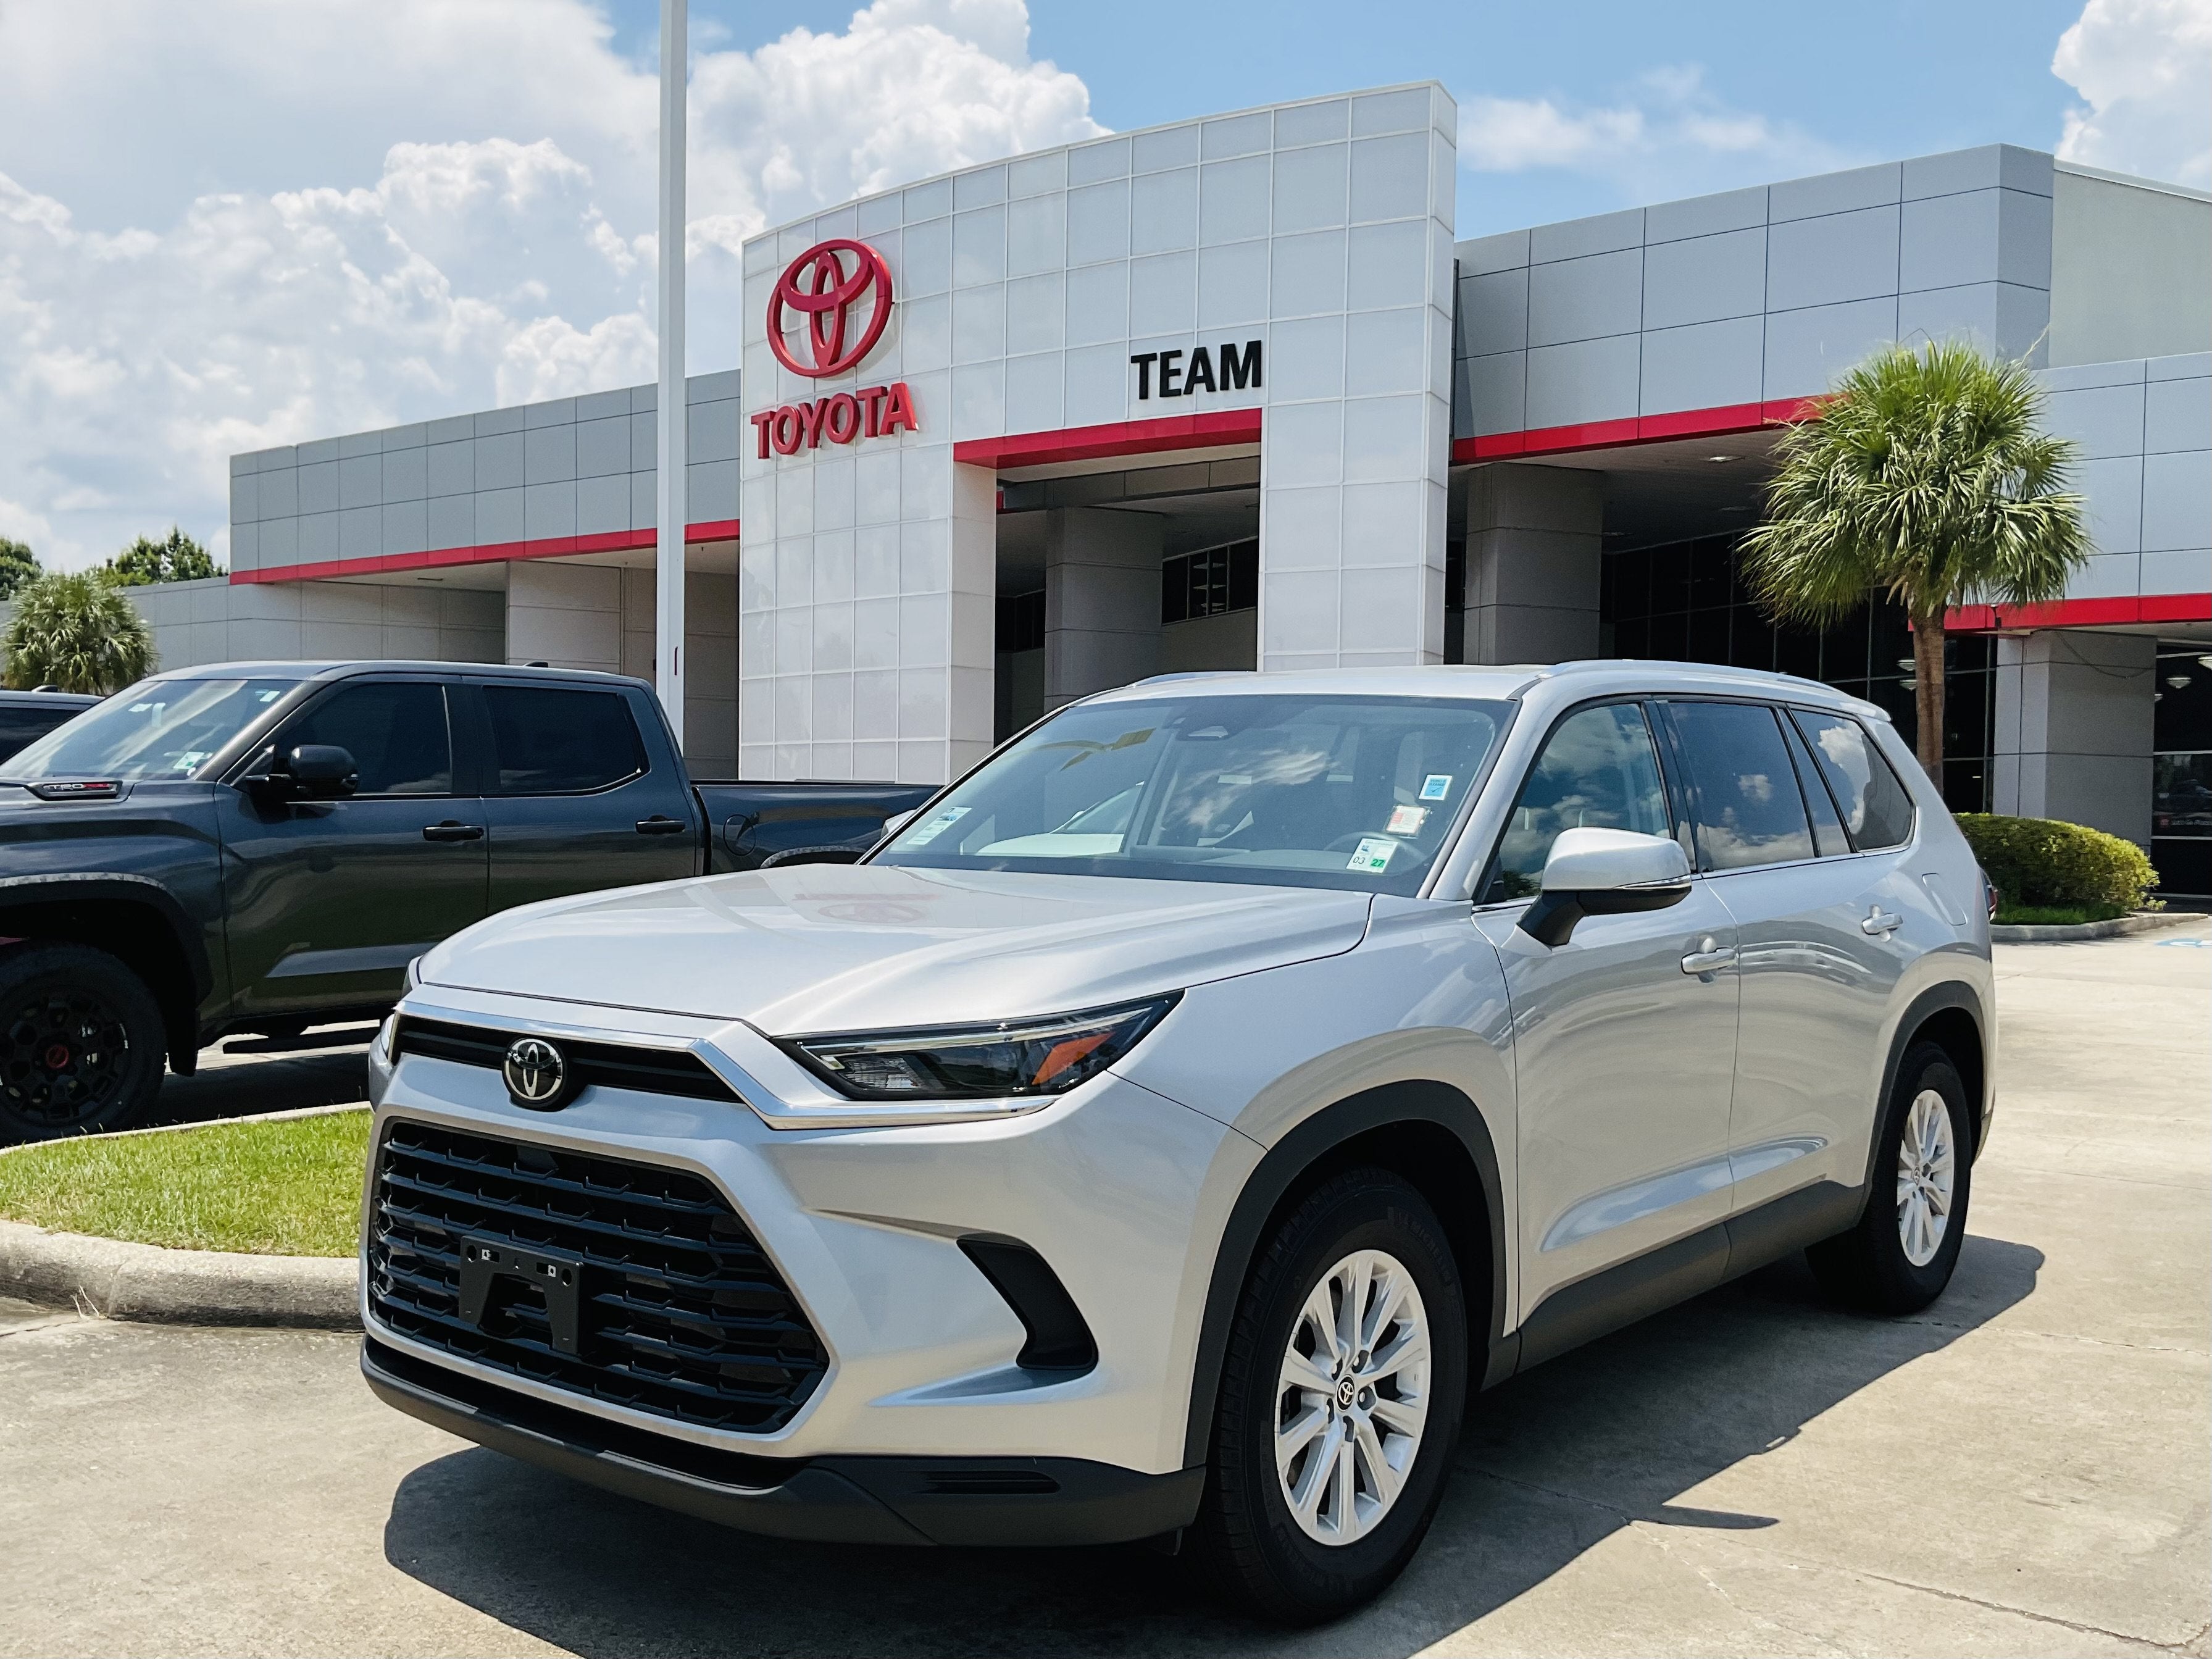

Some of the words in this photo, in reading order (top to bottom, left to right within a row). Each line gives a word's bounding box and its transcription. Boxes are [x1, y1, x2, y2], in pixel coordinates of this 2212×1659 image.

[1130, 340, 1261, 399] TEAM
[751, 382, 919, 459] TOYOTA
[1353, 856, 1366, 864] 03
[1371, 859, 1385, 867] 27
